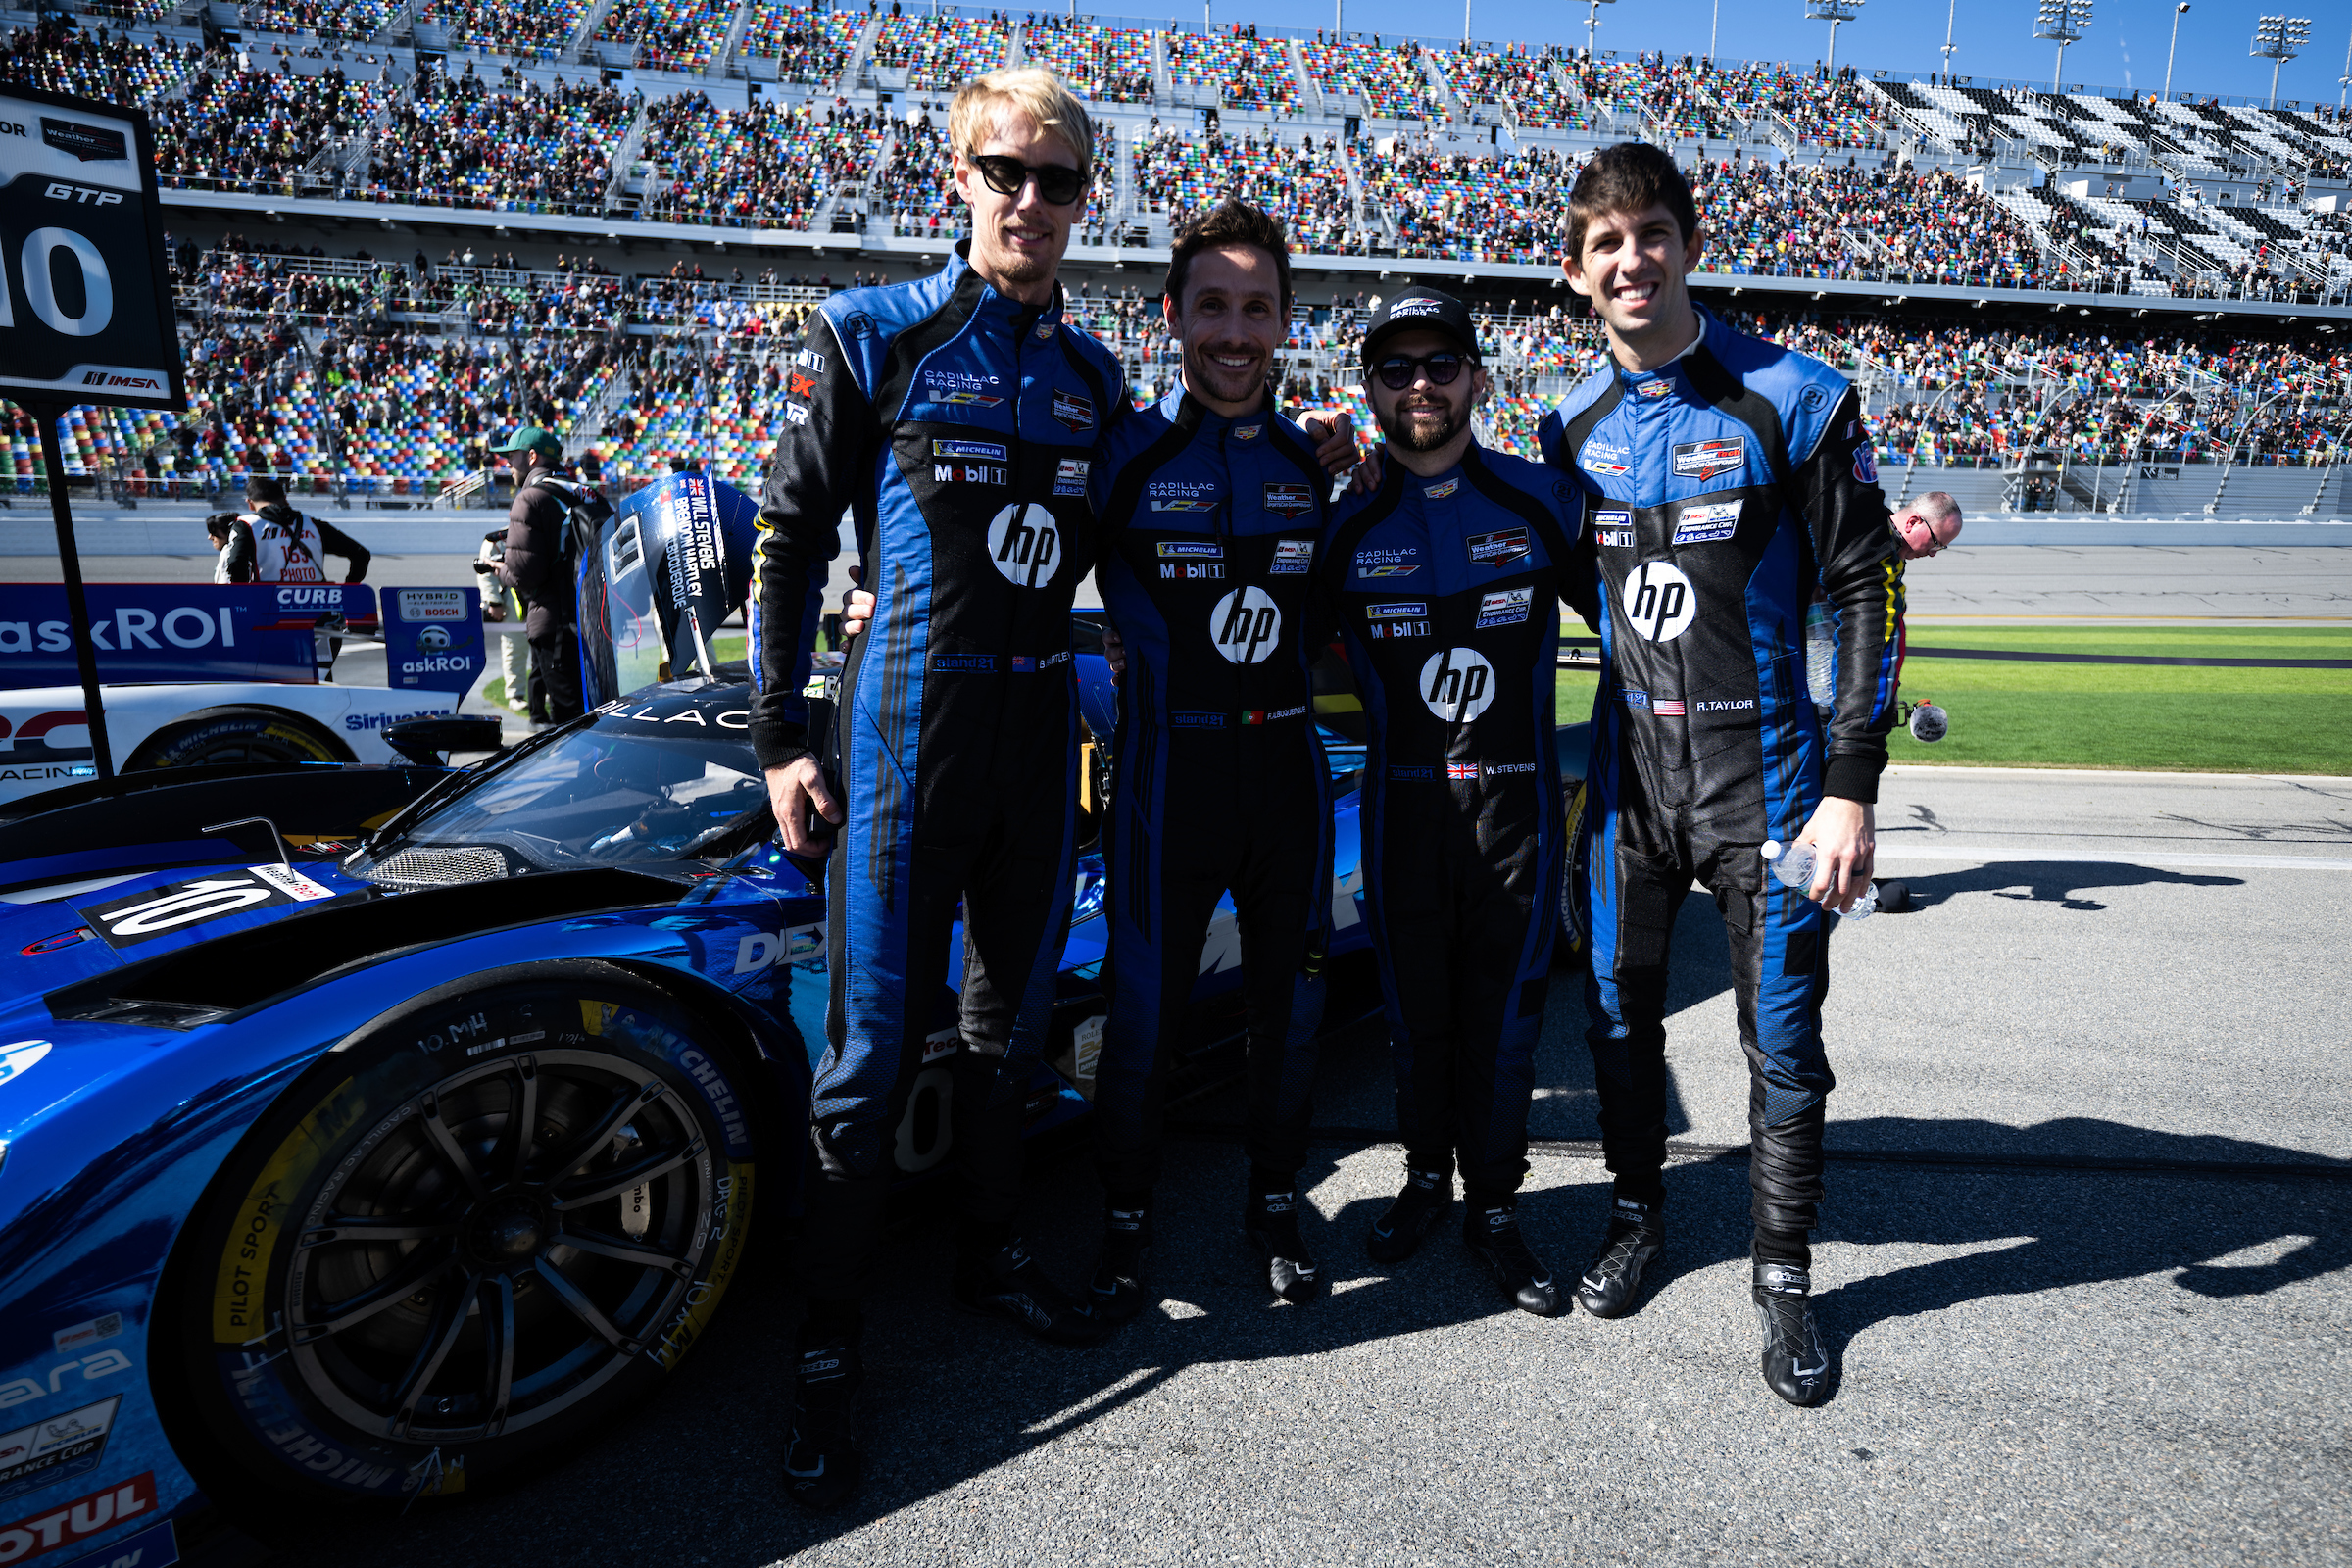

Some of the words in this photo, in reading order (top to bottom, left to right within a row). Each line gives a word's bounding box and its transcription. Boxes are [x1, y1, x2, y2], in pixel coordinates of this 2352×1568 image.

[44, 183, 124, 206] GTP
[108, 375, 162, 390] IMSA
[924, 369, 1000, 385] CADILLAC
[925, 377, 983, 391] RACING
[956, 446, 1002, 457] MICHELIN
[1584, 448, 1618, 461] RACING
[1586, 440, 1631, 455] CADILLAC
[1676, 449, 1741, 465] WeatherTech
[1149, 481, 1216, 491] CADILLAC
[1149, 489, 1200, 498] RACING
[690, 496, 709, 520] WILL
[674, 496, 696, 548] BRENDON
[694, 521, 716, 569] STEVENS
[997, 502, 1057, 588] hp
[1356, 548, 1417, 559] CADILLAC
[1356, 556, 1402, 565] RACING
[280, 567, 316, 583] PHOTO
[683, 547, 703, 597] HARTLEY
[277, 588, 343, 606] CURB
[407, 592, 458, 601] HYBRID
[1632, 563, 1686, 642] hp
[425, 608, 459, 617] BOSCH
[1382, 606, 1422, 614] MICHELIN
[1218, 585, 1276, 664] hp
[402, 655, 471, 674] askROI
[1428, 646, 1489, 723] hp
[1696, 699, 1754, 711] R.TAYLOR
[1485, 762, 1536, 775] W.STEVENS
[99, 878, 272, 936] 10
[735, 1175, 749, 1222] PILOT
[229, 1265, 252, 1328] PILOT
[241, 1186, 282, 1261] SPORT
[39, 1424, 103, 1453] MICHELIN
